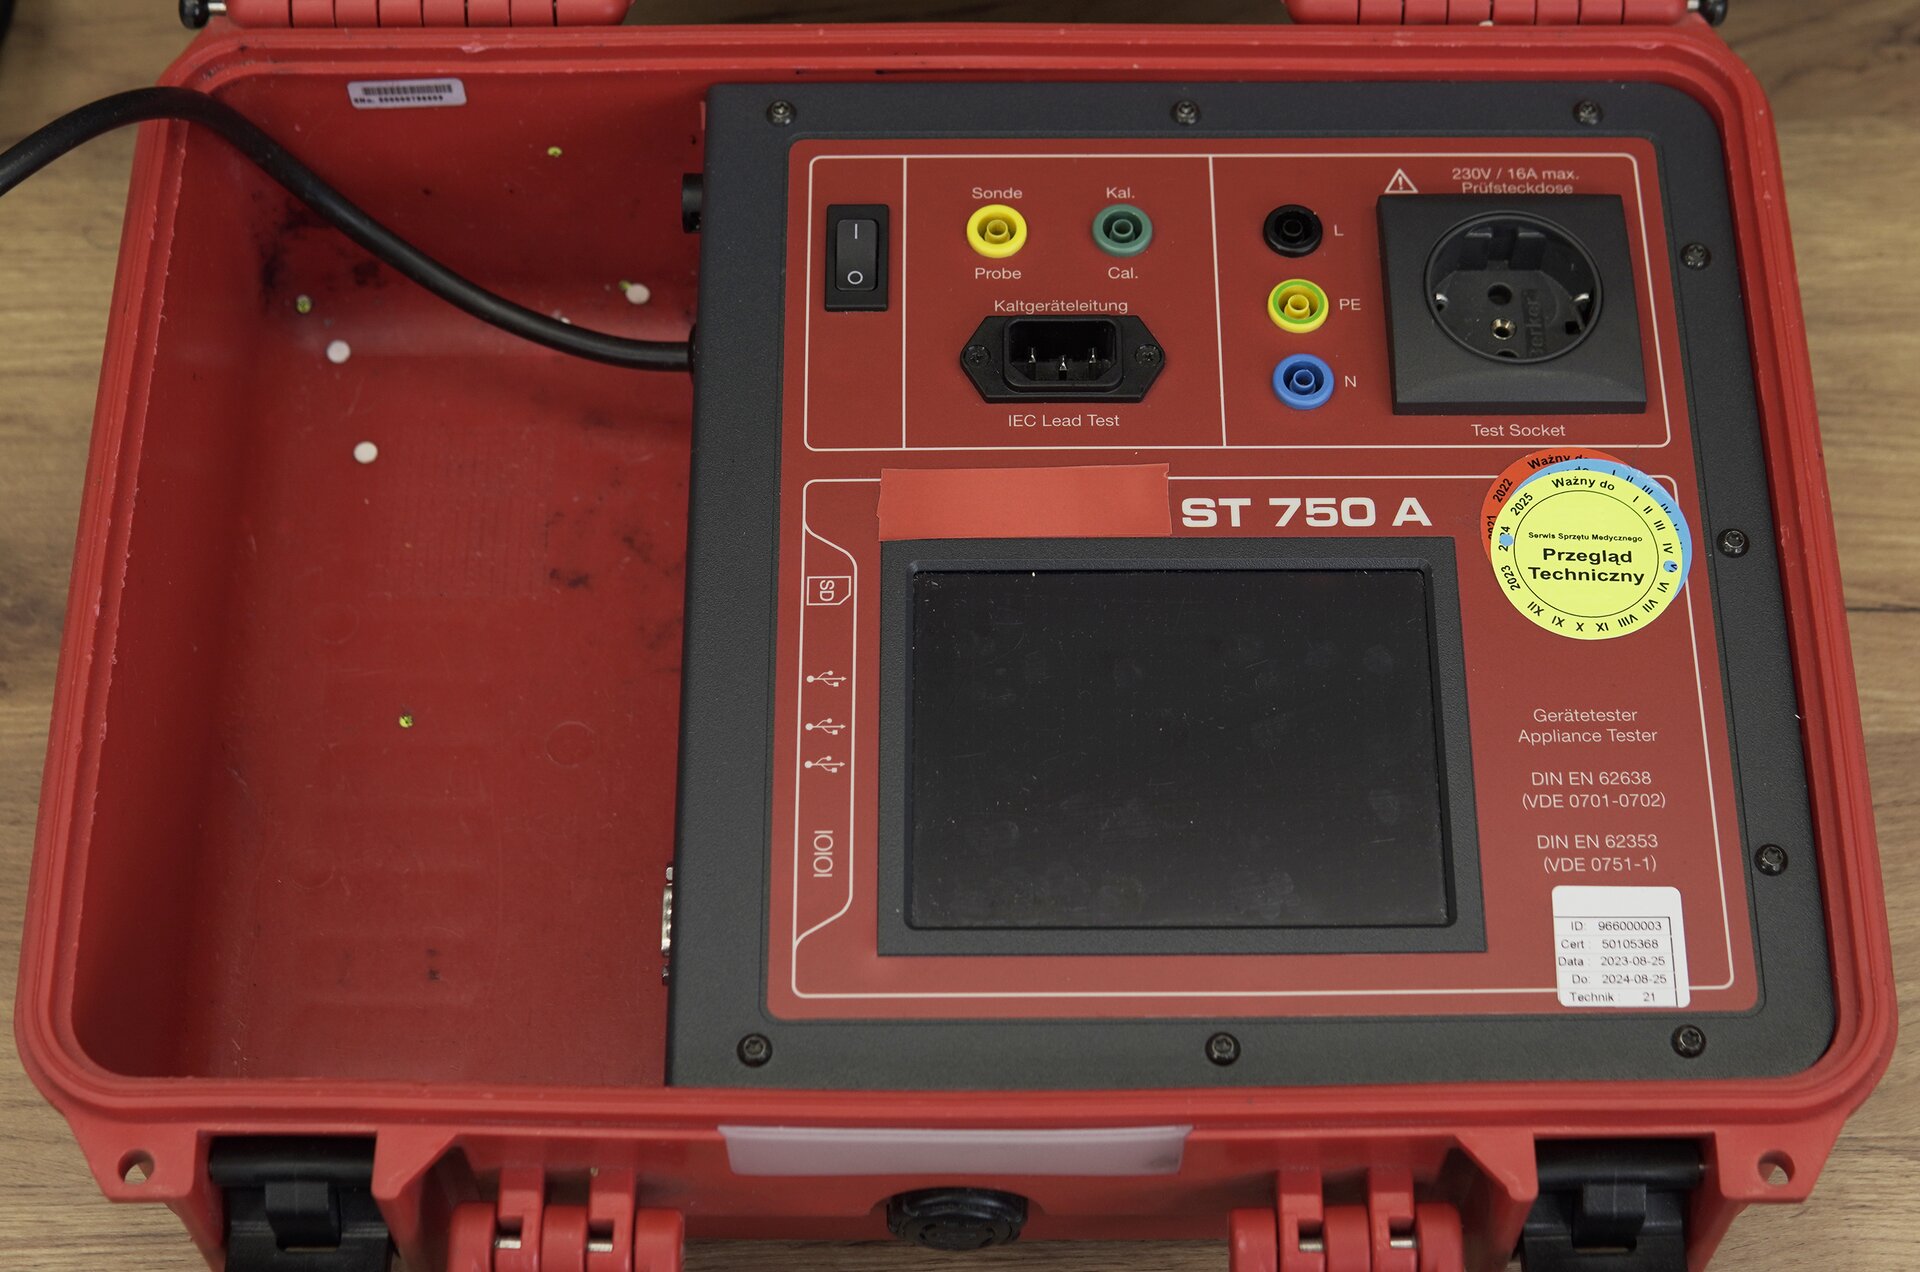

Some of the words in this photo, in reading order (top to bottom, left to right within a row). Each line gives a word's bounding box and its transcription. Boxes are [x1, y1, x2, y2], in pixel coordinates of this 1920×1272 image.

[1452, 168, 1492, 180] 230V
[1508, 168, 1538, 180] 16A
[1541, 171, 1579, 180] max.
[971, 187, 1023, 200] Sonde
[1106, 187, 1135, 199] Kal.
[1461, 182, 1573, 194] Prüfsteckdose
[1333, 225, 1344, 237] L
[974, 268, 1022, 280] Probe
[1107, 267, 1139, 280] Cal.
[994, 300, 1128, 315] Kaltgeräteleitung
[1339, 299, 1361, 311] PE
[1344, 376, 1357, 388] N
[1008, 415, 1037, 428] IEC
[1042, 415, 1082, 427] Lead
[1086, 415, 1120, 427] Test
[1470, 424, 1505, 437] Test
[1509, 424, 1566, 437] Socket
[1527, 454, 1571, 470] Ważny
[1551, 475, 1596, 489] Ważny
[1599, 480, 1615, 491] do
[1492, 478, 1513, 503] 2022
[1510, 492, 1534, 516] 2025
[1643, 505, 1653, 515] II
[1182, 498, 1251, 527] ST
[1269, 497, 1376, 527] 750
[1392, 498, 1432, 526] A
[1653, 519, 1666, 531] III
[1498, 525, 1511, 552] 24
[1528, 531, 1556, 539] Serwis
[1558, 532, 1590, 541] Sprzętu
[1591, 534, 1643, 543] Medycznego
[1662, 542, 1674, 554] IV
[1543, 548, 1633, 565] Przegląd
[1500, 564, 1521, 591] 2023
[1528, 567, 1645, 586] Techniczny
[819, 579, 835, 601] SD
[1641, 598, 1659, 613] VII
[1575, 621, 1585, 632] X
[1533, 709, 1638, 723] Gerätetester
[1518, 729, 1602, 746] Appliance
[1606, 729, 1658, 742] Tester
[1531, 772, 1563, 786] DIN
[1568, 772, 1594, 786] EN
[1598, 772, 1652, 786] 62638
[1522, 794, 1564, 810] (VDE
[1569, 792, 1666, 809] 0701-0702)
[1536, 835, 1569, 850] DIN
[1574, 835, 1600, 849] EN
[1605, 834, 1659, 849] 62353
[1543, 857, 1586, 874] (VDE
[1590, 855, 1657, 873] 0751-1)
[1598, 921, 1662, 931] 966000003
[1602, 939, 1659, 949] 50105368
[1600, 956, 1666, 966] 2023-08-25
[1602, 974, 1667, 984] 2024-08-25
[1642, 992, 1655, 1002] 21
